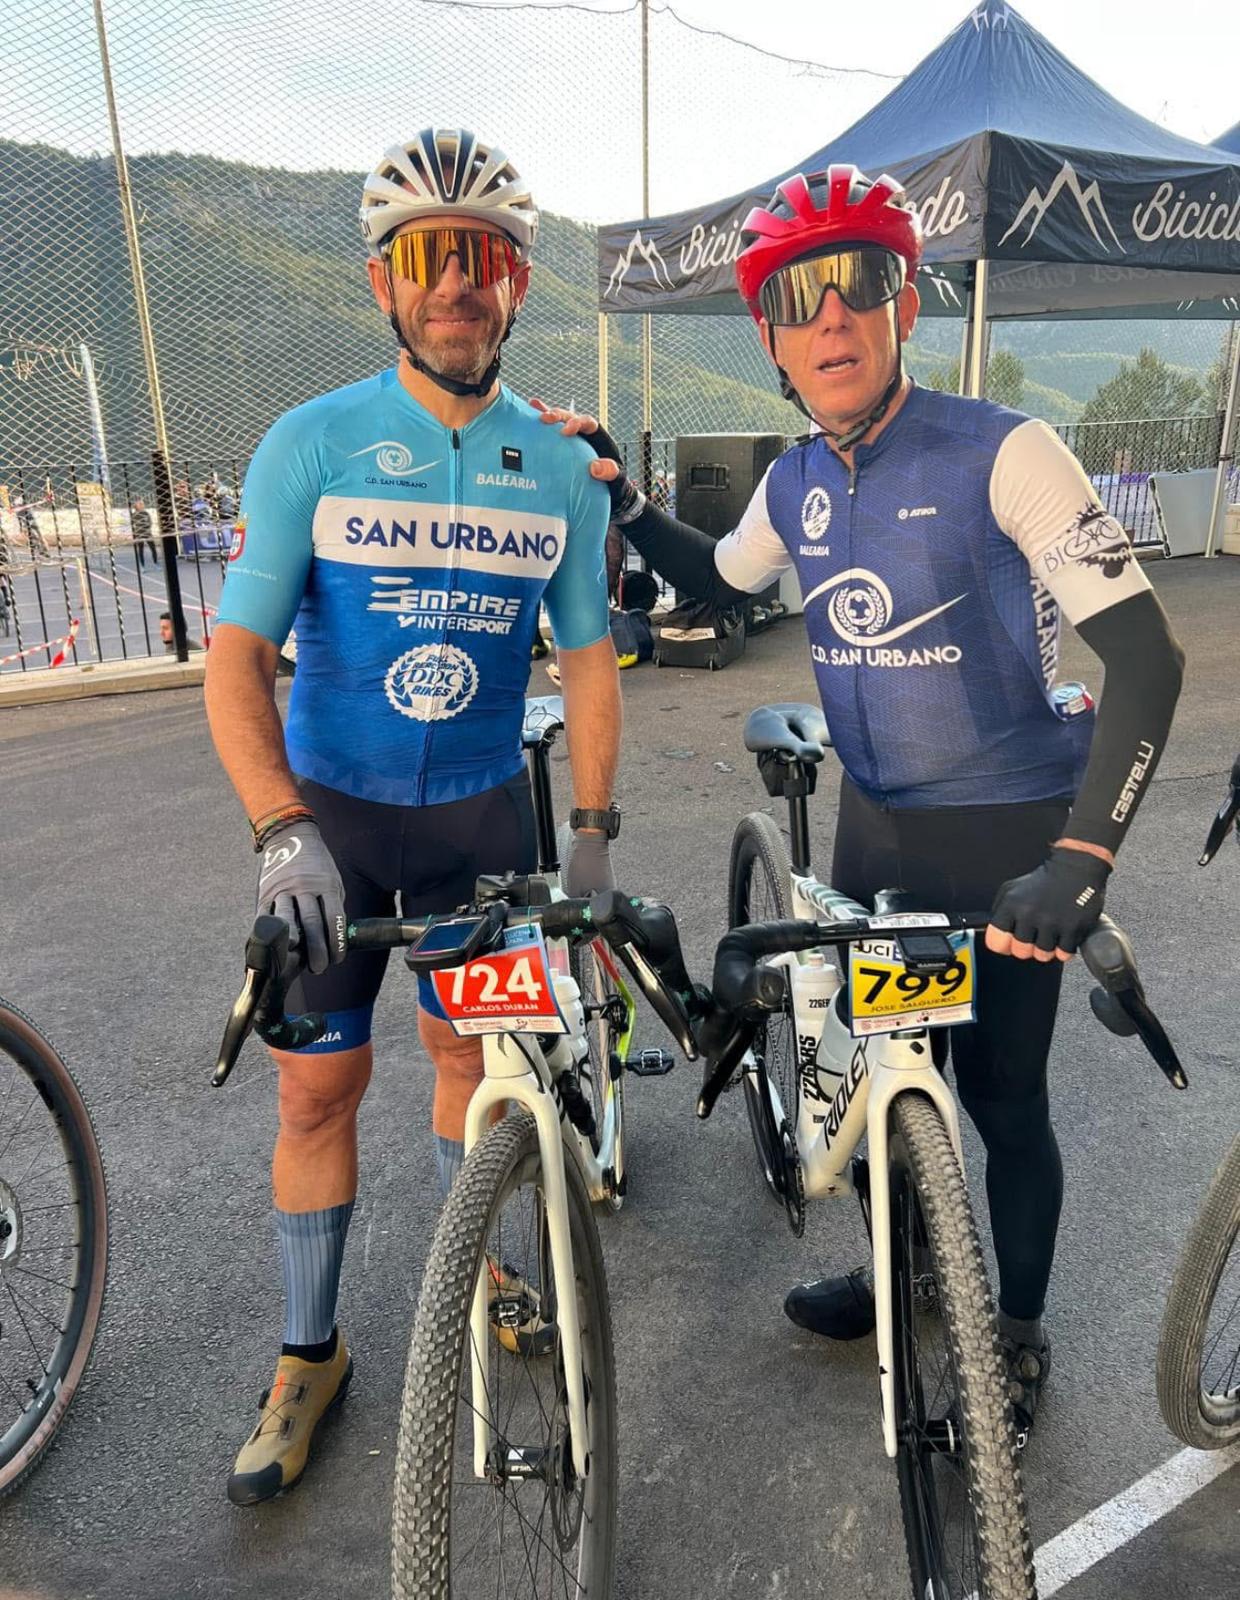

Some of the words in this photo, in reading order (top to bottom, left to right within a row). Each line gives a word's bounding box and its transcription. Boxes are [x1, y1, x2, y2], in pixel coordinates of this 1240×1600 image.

[1132, 182, 1240, 242] Bicicl
[380, 478, 395, 486] SAN
[396, 480, 428, 489] URBANO
[345, 516, 417, 549] SAN
[430, 520, 559, 562] URBANO
[417, 614, 513, 636] INTERSPORT
[1030, 577, 1058, 692] ALEARIA
[830, 648, 862, 667] SAN
[866, 645, 962, 668] URBANO
[411, 685, 452, 698] BIKES
[438, 957, 543, 1006] 724
[859, 958, 967, 1005] 799
[463, 1004, 501, 1013] CARLOS
[503, 1003, 539, 1012] DURAN
[808, 998, 831, 1009] 226ER
[871, 1004, 897, 1013] JOSE
